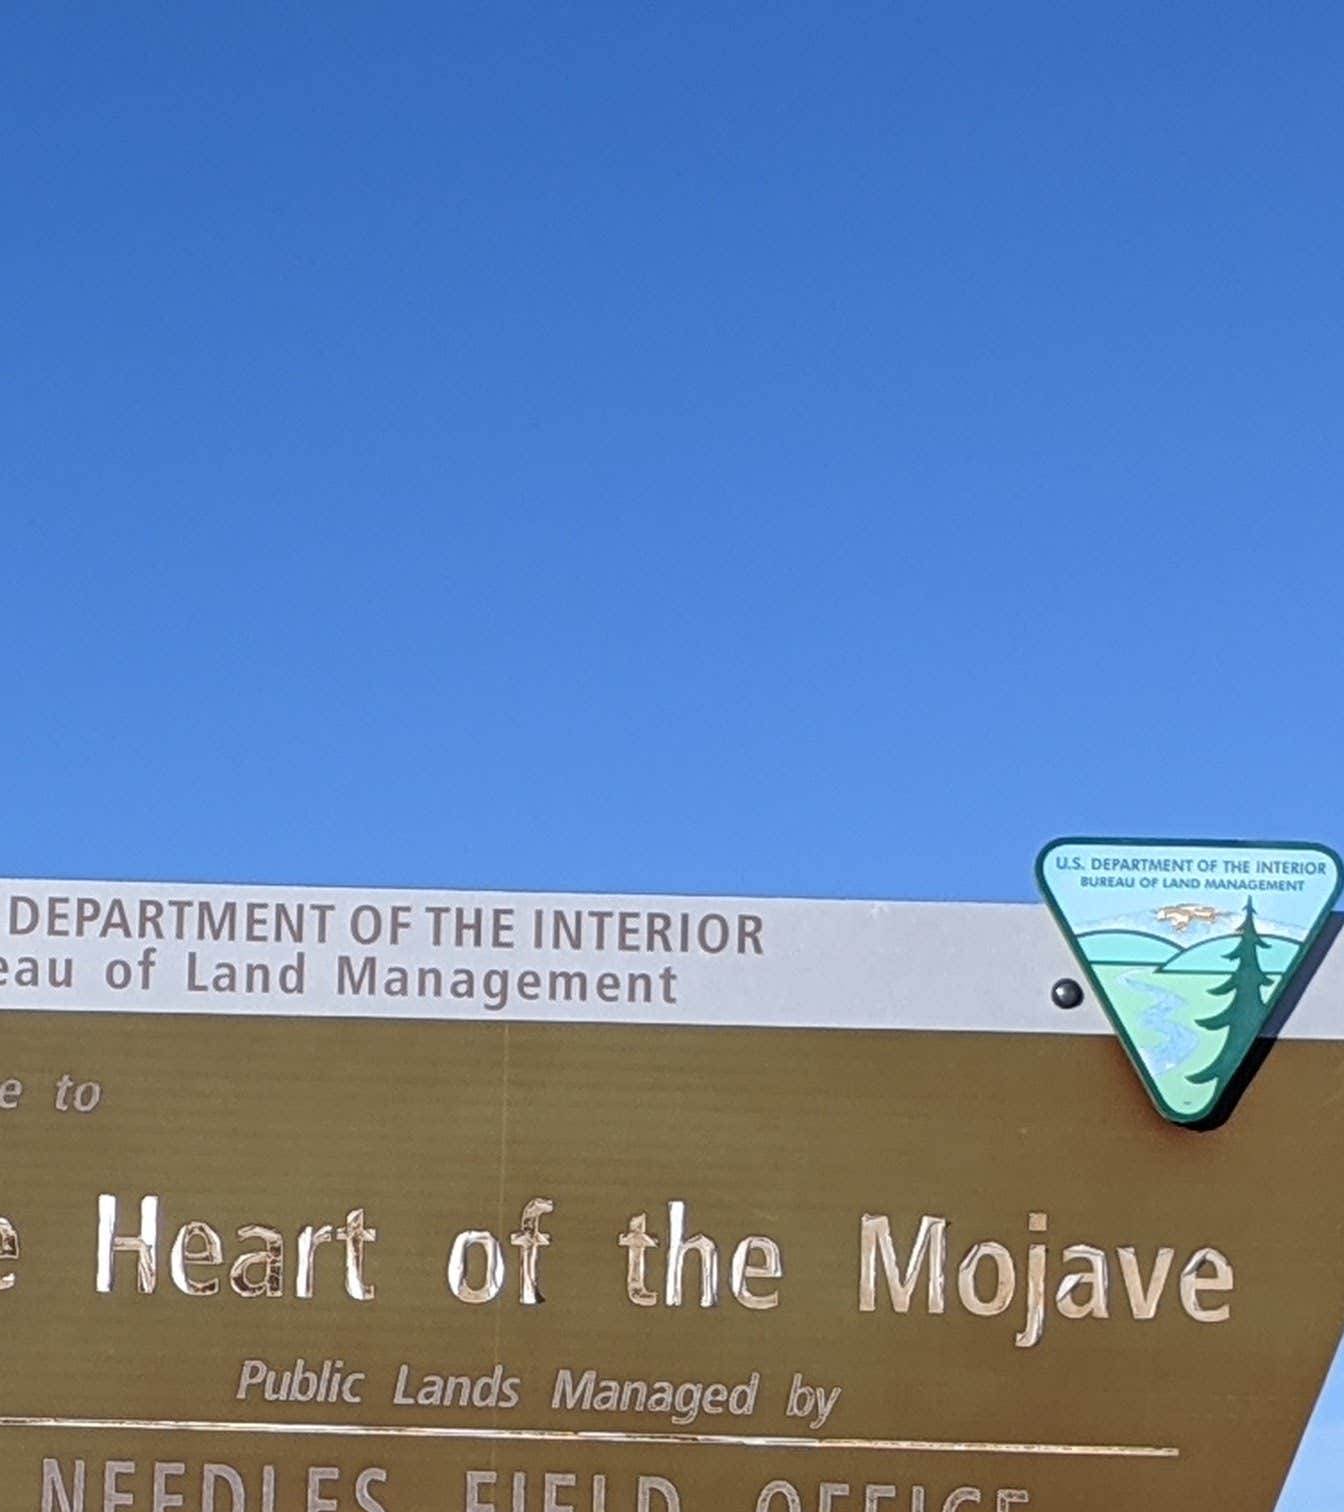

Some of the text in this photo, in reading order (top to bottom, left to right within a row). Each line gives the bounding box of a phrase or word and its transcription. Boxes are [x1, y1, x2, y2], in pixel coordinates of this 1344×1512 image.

[1056, 857, 1326, 876] U.S. DEPARTMENT OF THE INTERIOR
[1080, 876, 1305, 892] BUREAU OF LAND MANAGEMENT
[8, 895, 336, 945] DEPARTMENT
[349, 904, 411, 946] OF
[424, 906, 516, 950] THE
[533, 908, 765, 956] INTERIOR
[104, 946, 158, 991] of
[185, 951, 306, 995] Land
[336, 954, 678, 1012] Management
[55, 1072, 102, 1113] to
[96, 1193, 378, 1302] Heart
[446, 1197, 555, 1305] of
[617, 1200, 784, 1310] the
[858, 1211, 1235, 1348] Mojave
[236, 1358, 842, 1429] Public Lands Managed by
